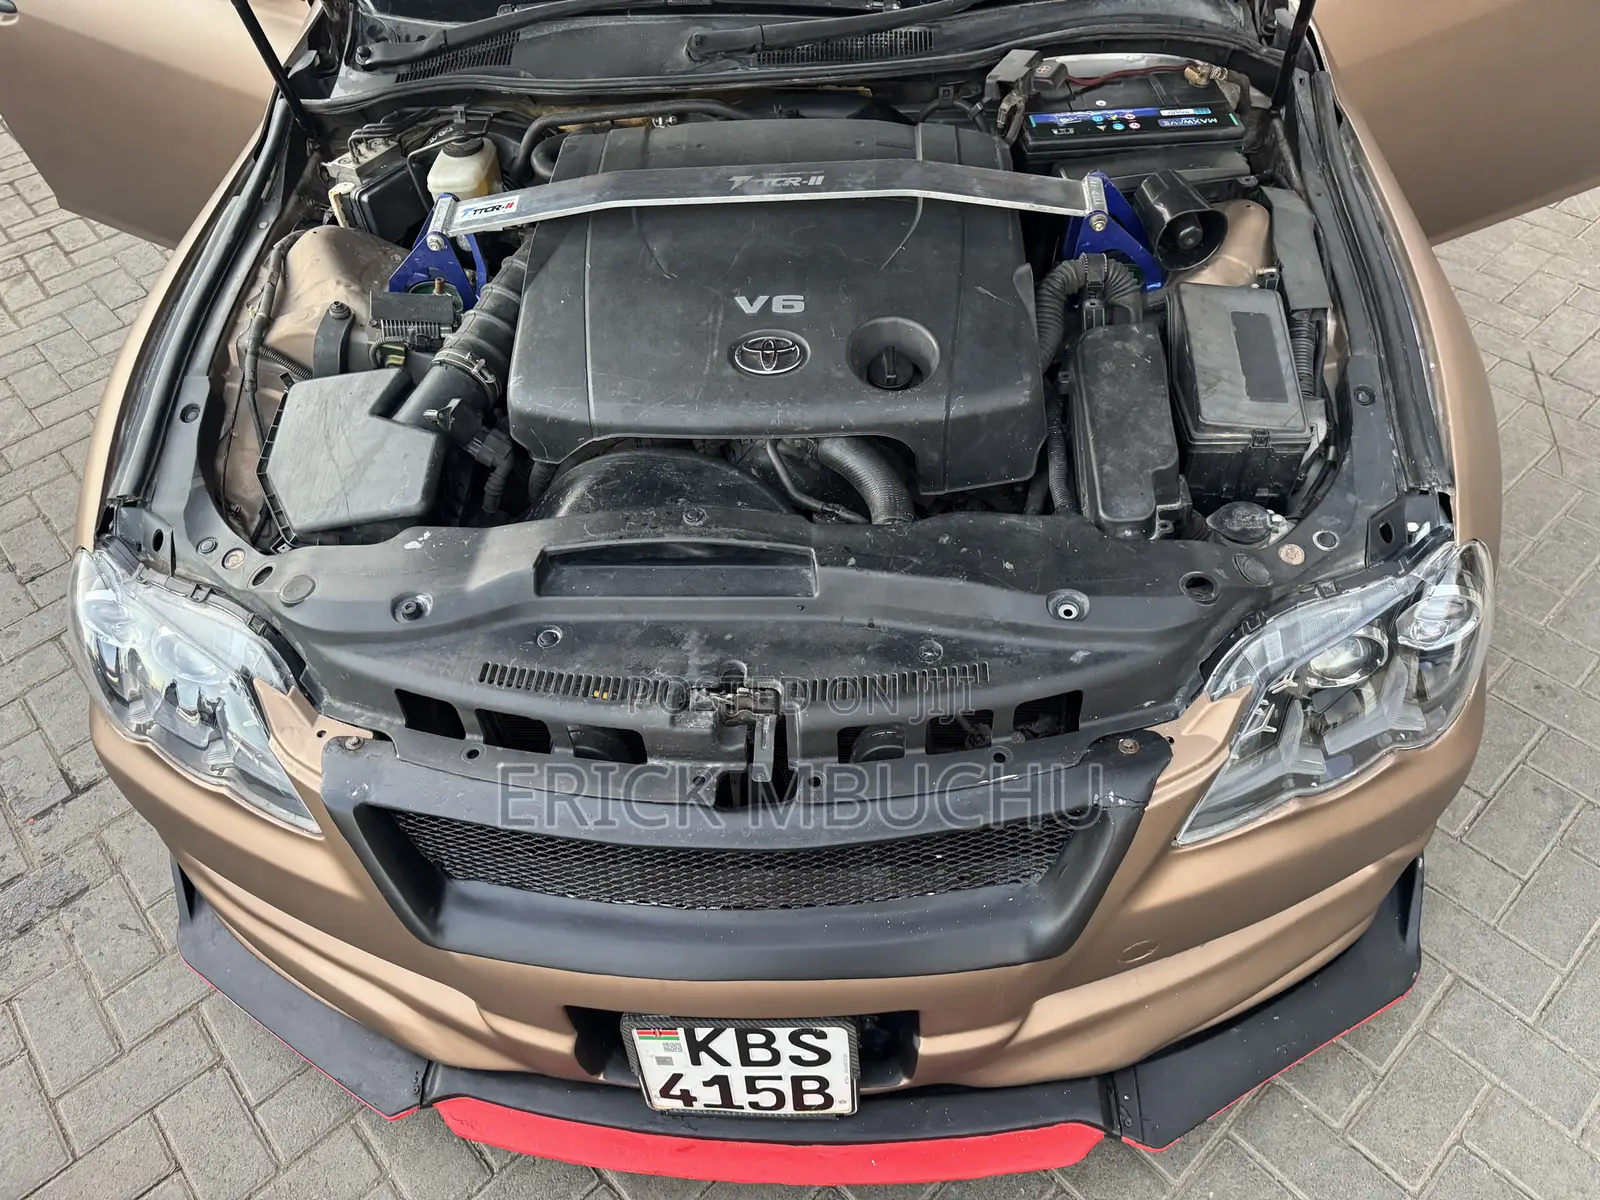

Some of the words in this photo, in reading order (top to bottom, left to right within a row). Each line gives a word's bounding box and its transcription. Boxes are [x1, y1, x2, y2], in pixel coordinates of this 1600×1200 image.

[734, 294, 805, 315] V6
[684, 1027, 832, 1067] KBS
[659, 1072, 835, 1112] 415B
